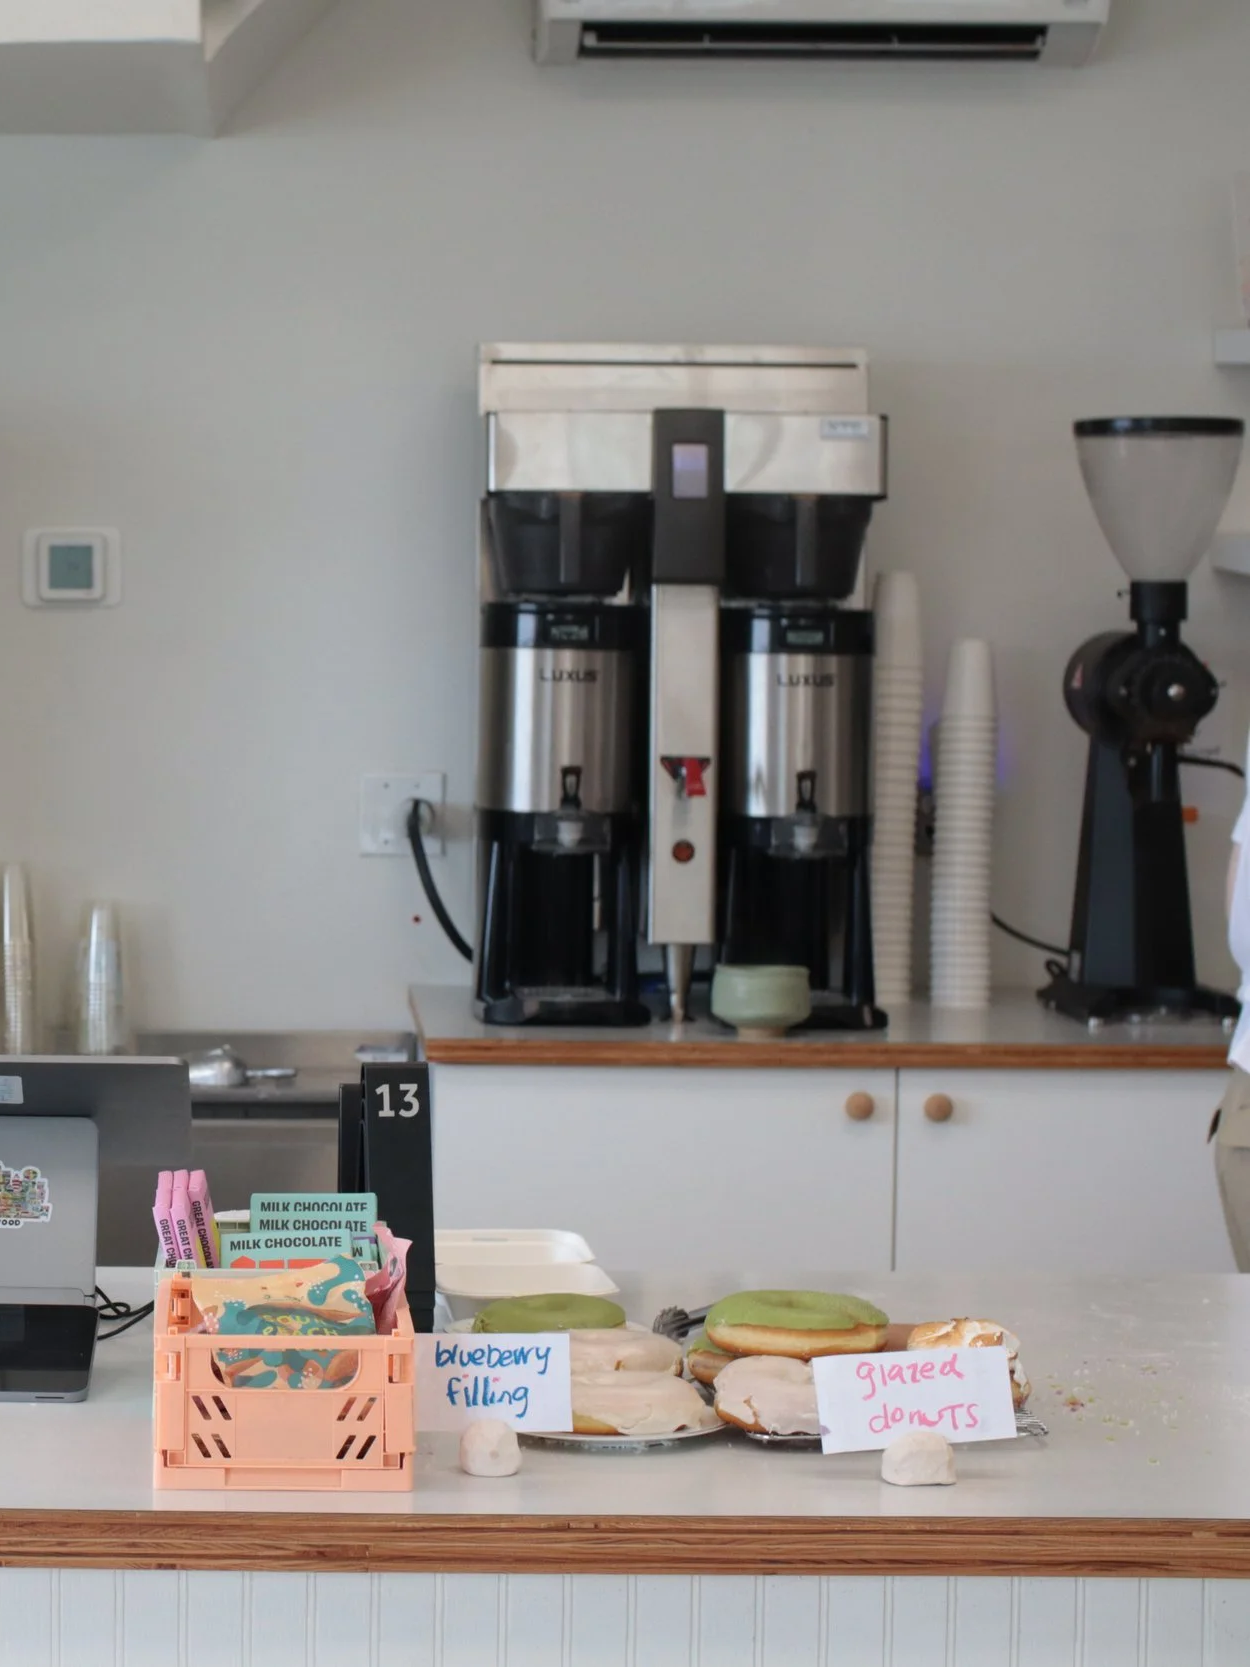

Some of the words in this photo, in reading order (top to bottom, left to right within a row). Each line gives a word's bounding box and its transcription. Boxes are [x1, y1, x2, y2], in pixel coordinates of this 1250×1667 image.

[539, 668, 598, 683] LUXUS
[777, 673, 835, 687] LUXUS
[375, 1083, 420, 1118] 13
[192, 1200, 206, 1228] GREAT
[260, 1201, 290, 1212] MILK
[159, 1218, 174, 1246] GREAT
[176, 1219, 190, 1246] GREAT
[259, 1218, 290, 1231] MILK
[292, 1220, 367, 1232] CHOCOLATE
[229, 1239, 262, 1252] MILK
[264, 1236, 342, 1249] CHOCOLATE
[855, 1352, 966, 1401] glazed
[446, 1374, 529, 1419] filling
